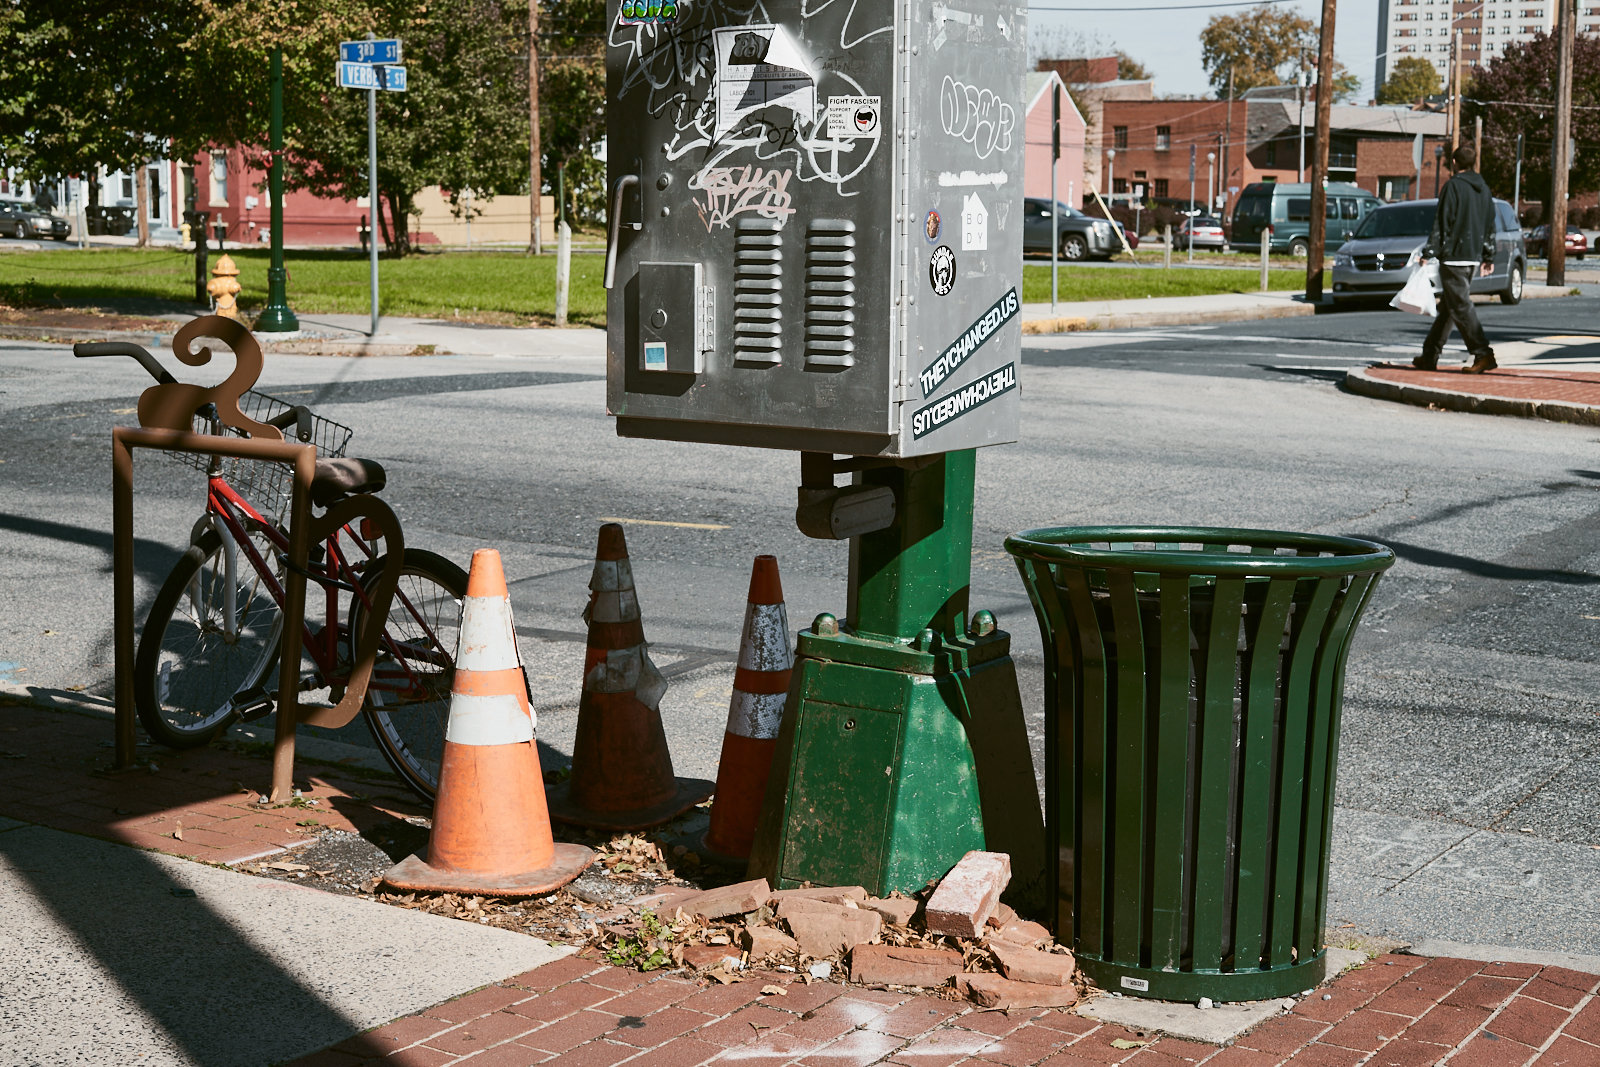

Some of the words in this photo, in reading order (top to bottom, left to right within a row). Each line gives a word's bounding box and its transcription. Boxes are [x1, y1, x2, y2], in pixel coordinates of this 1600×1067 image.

[357, 44, 375, 62] 3RD
[386, 45, 397, 58] ST
[394, 72, 404, 86] ST
[920, 291, 1018, 395] THEYCHANGED.US
[913, 366, 1016, 436] THEYCHANGED.US
